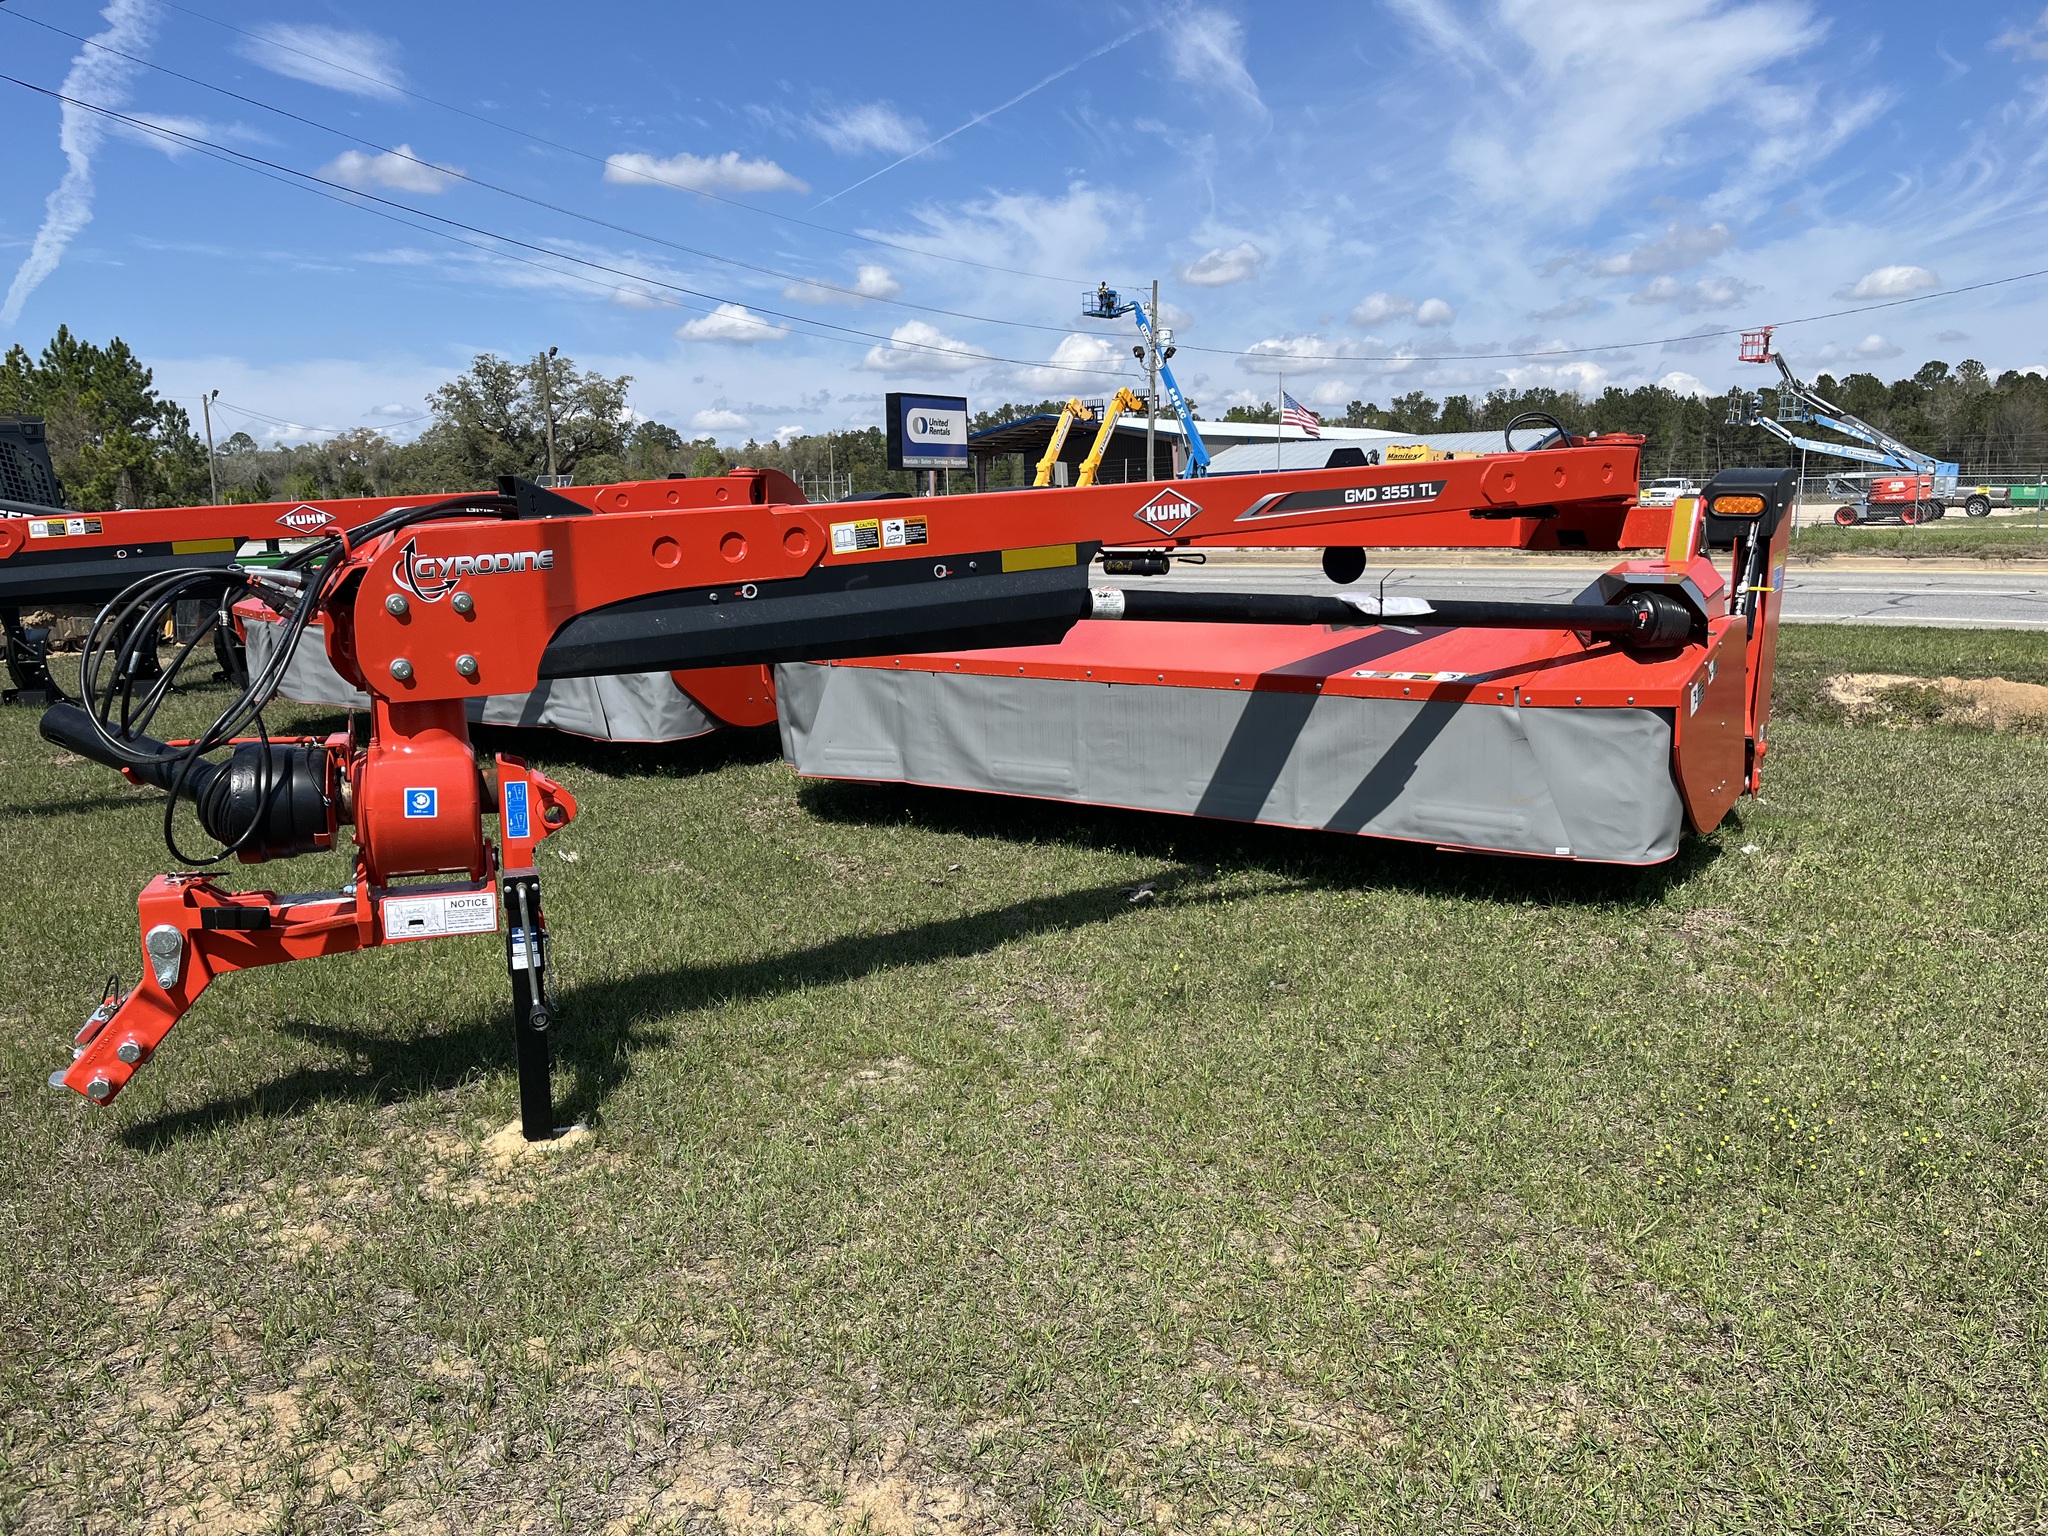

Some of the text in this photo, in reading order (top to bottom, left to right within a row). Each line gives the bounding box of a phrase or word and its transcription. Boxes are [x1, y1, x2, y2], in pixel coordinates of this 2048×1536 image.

[929, 418, 949, 427] United
[929, 427, 951, 435] Rentals
[1345, 483, 1437, 503] GMD 3551 TL
[1146, 503, 1191, 522] KUHN
[285, 513, 327, 526] KUHN
[415, 550, 554, 579] GYRODINE
[450, 898, 488, 908] NOTICE
